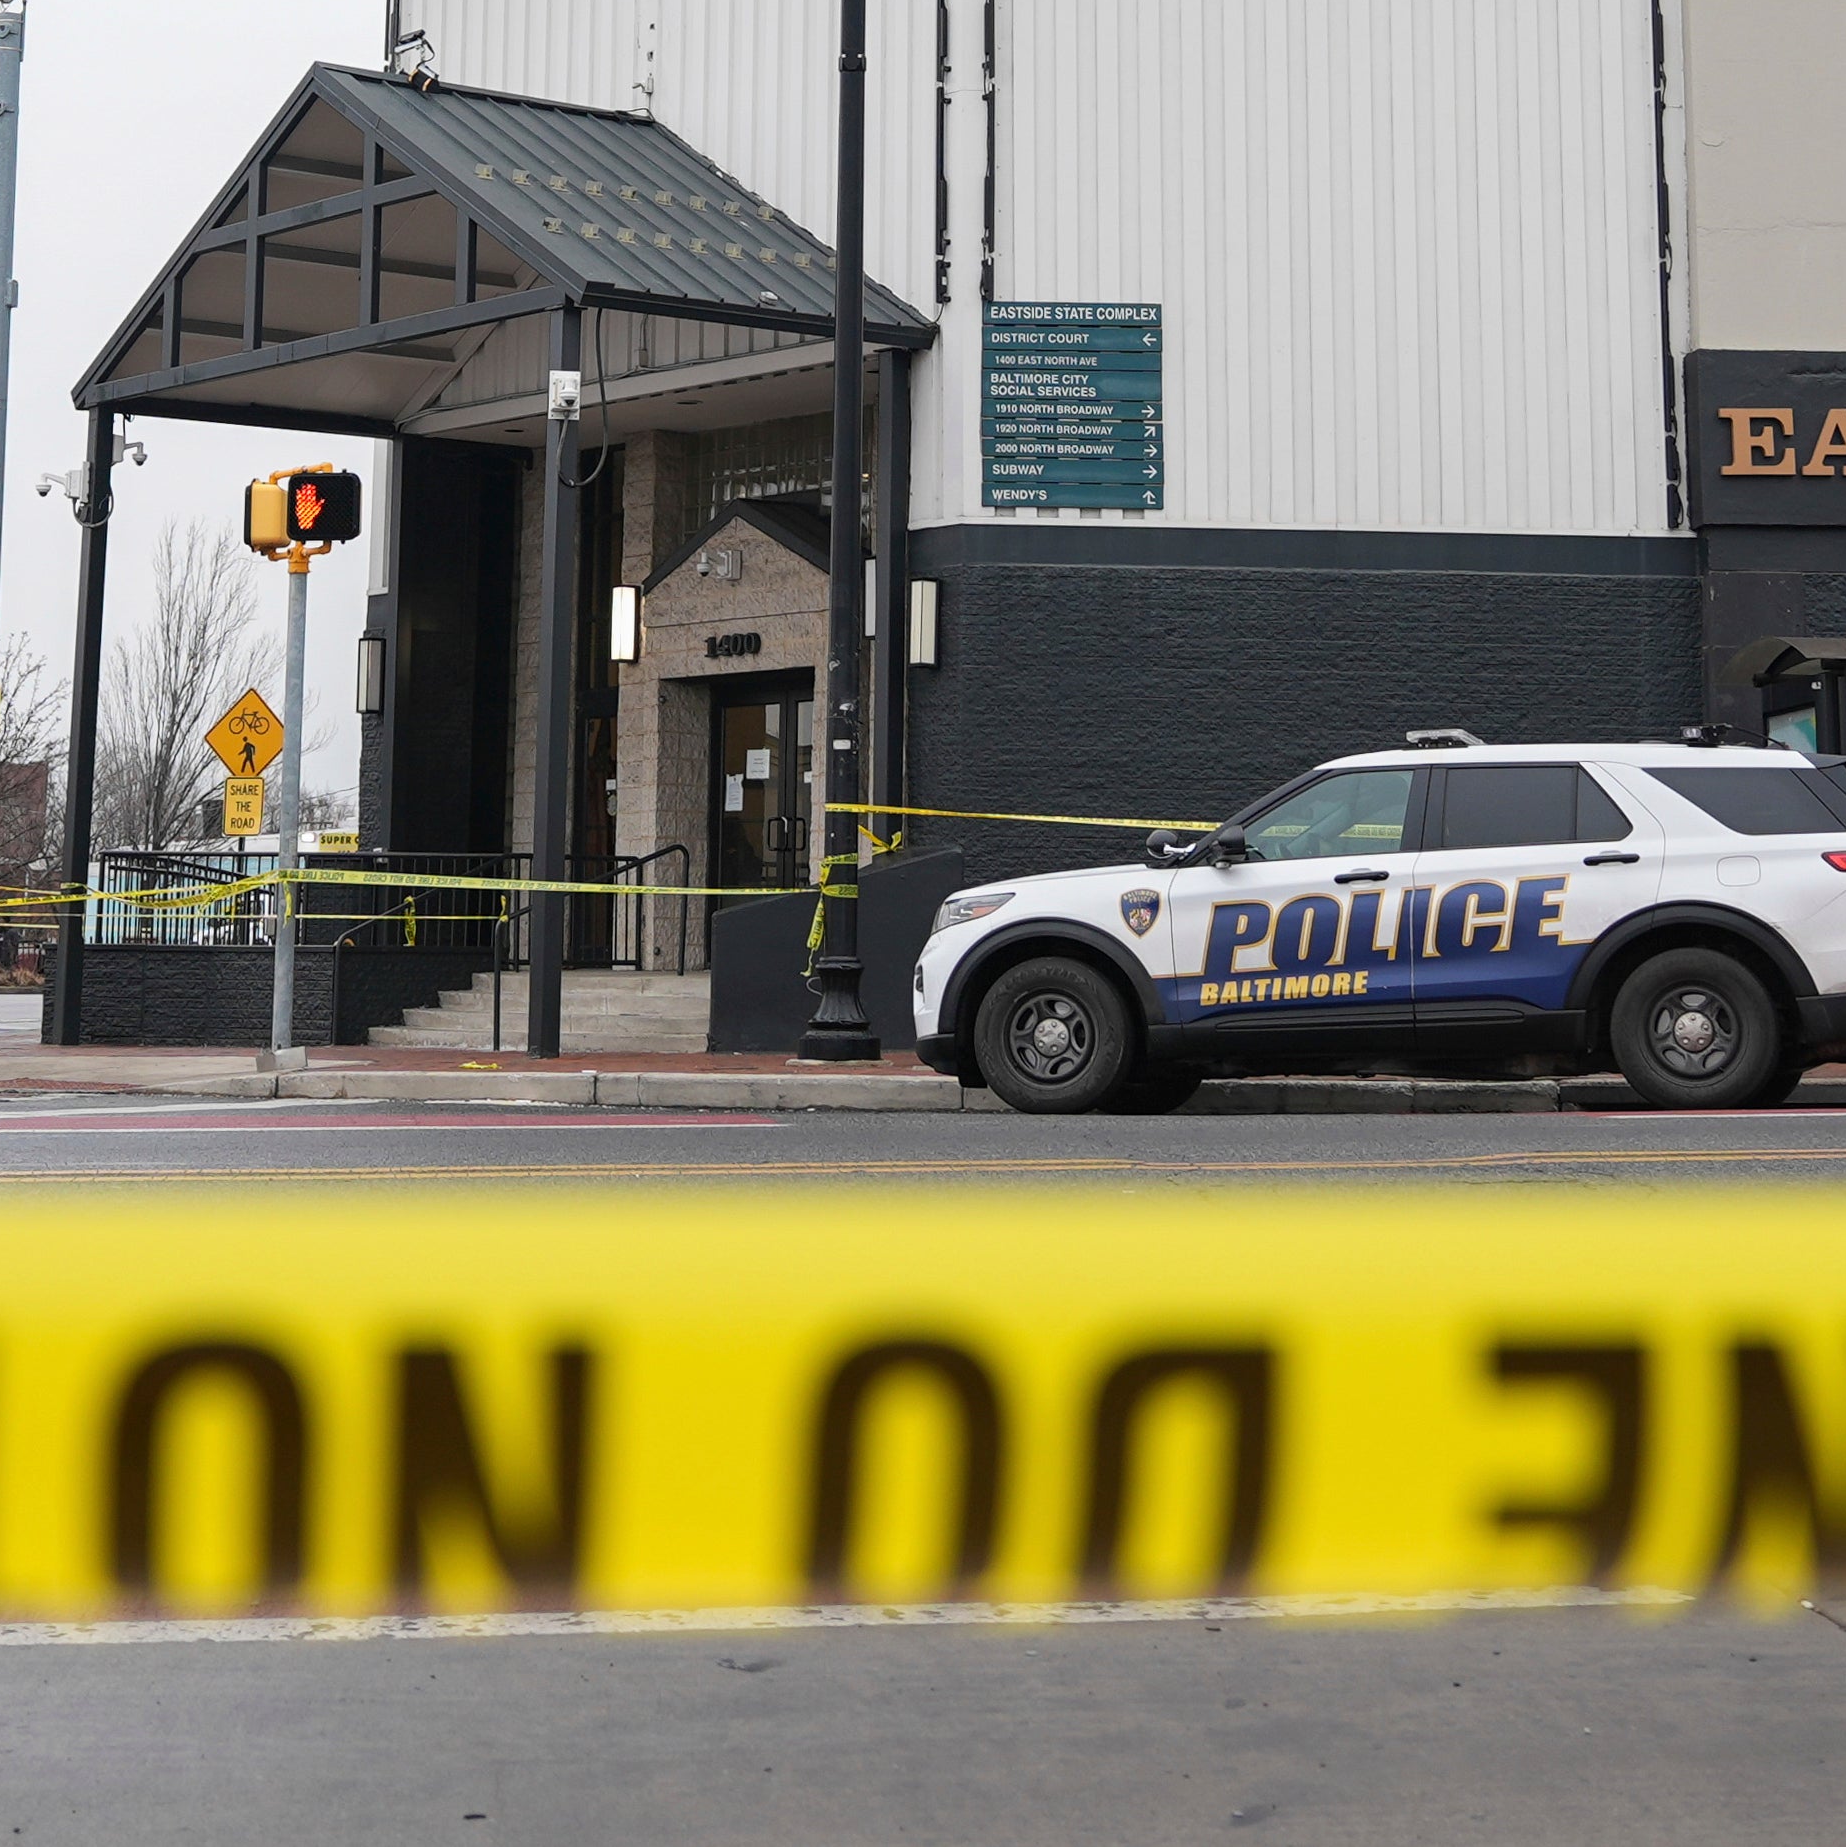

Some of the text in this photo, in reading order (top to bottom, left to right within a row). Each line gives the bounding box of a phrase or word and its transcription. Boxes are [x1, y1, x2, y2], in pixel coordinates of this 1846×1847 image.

[990, 306, 1157, 321] EASTSIDE STATE COMPLEX
[991, 333, 1089, 344] DISTRICT COURT
[995, 356, 1098, 366] 1400 EAST NORTH AVE
[990, 373, 1089, 385] BALTIMORE CITY
[990, 386, 1097, 397] SOCIAL SERVICES
[995, 404, 1114, 415] 1910 NORTH BROADWAY
[1019, 424, 1054, 434] NORTH
[1056, 425, 1113, 435] BROADWAY
[995, 444, 1115, 455] 2000 NORTH BROADWAY
[992, 464, 1044, 475] SUBWAY
[992, 489, 1048, 501] WENDY'S
[704, 632, 762, 658] 1400
[230, 784, 260, 796] SHARE
[236, 801, 252, 812] THE
[230, 817, 255, 829] ROAD
[320, 835, 352, 844] SUPER
[1202, 873, 1571, 974] POLICE
[1199, 970, 1369, 1006] BALTIMORE
[798, 1332, 1285, 1604] DO
